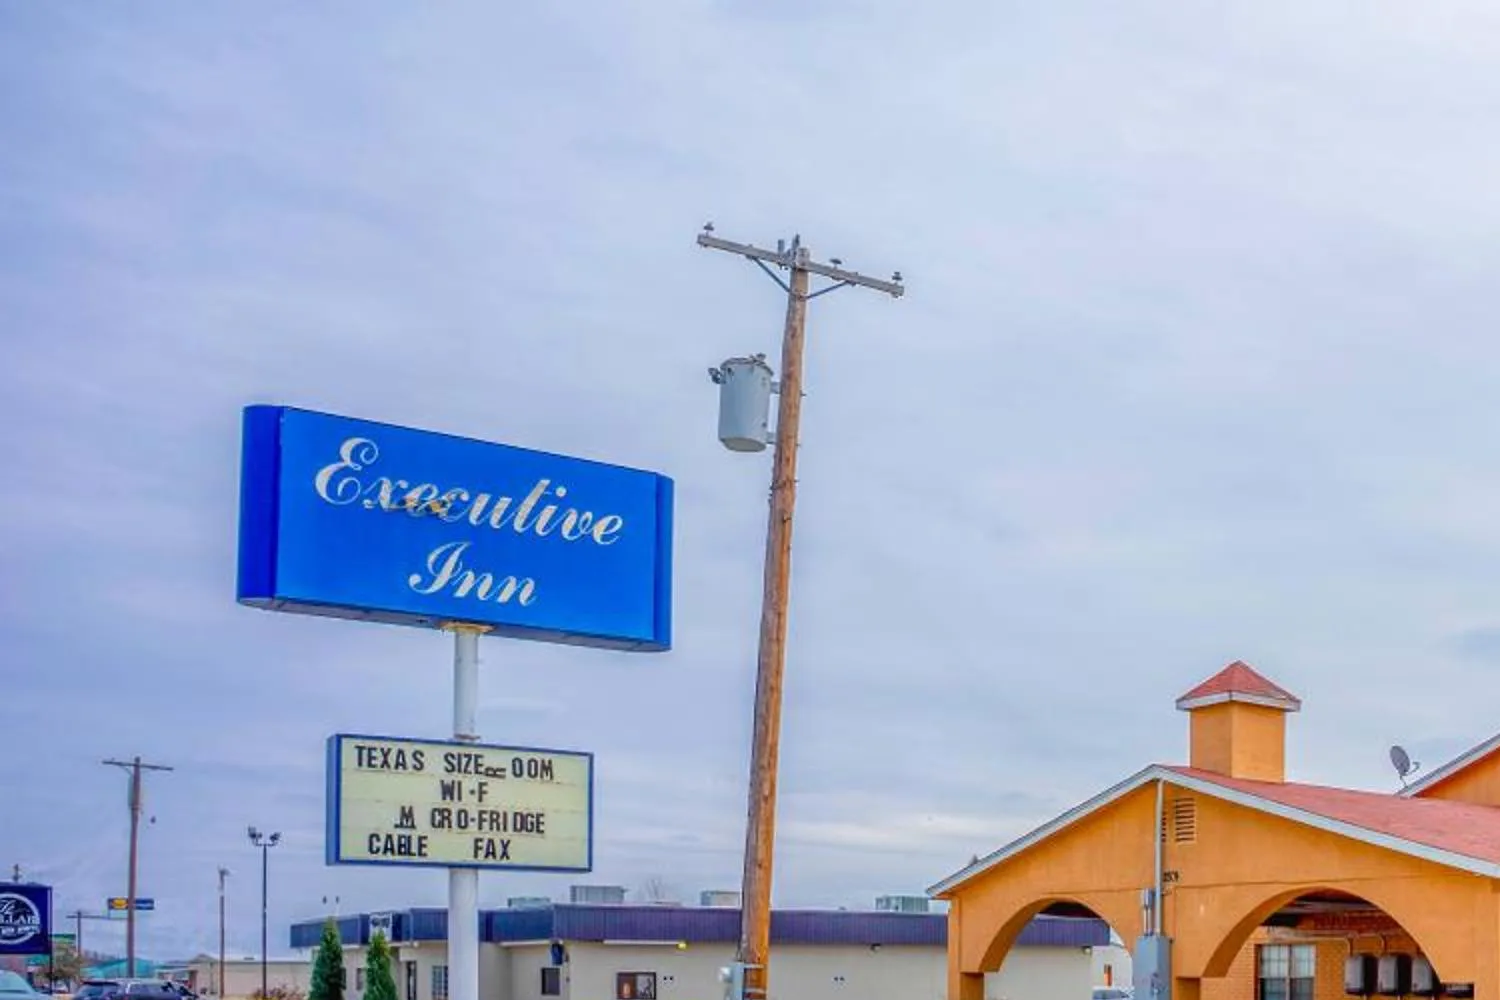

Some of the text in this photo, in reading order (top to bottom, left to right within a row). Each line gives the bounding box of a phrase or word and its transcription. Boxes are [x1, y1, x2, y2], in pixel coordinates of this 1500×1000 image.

[313, 436, 624, 545] Executive
[408, 540, 538, 607] Inn
[354, 744, 425, 771] TEXAS
[443, 751, 485, 775] SIZE
[368, 832, 511, 861] CABLE FAX
